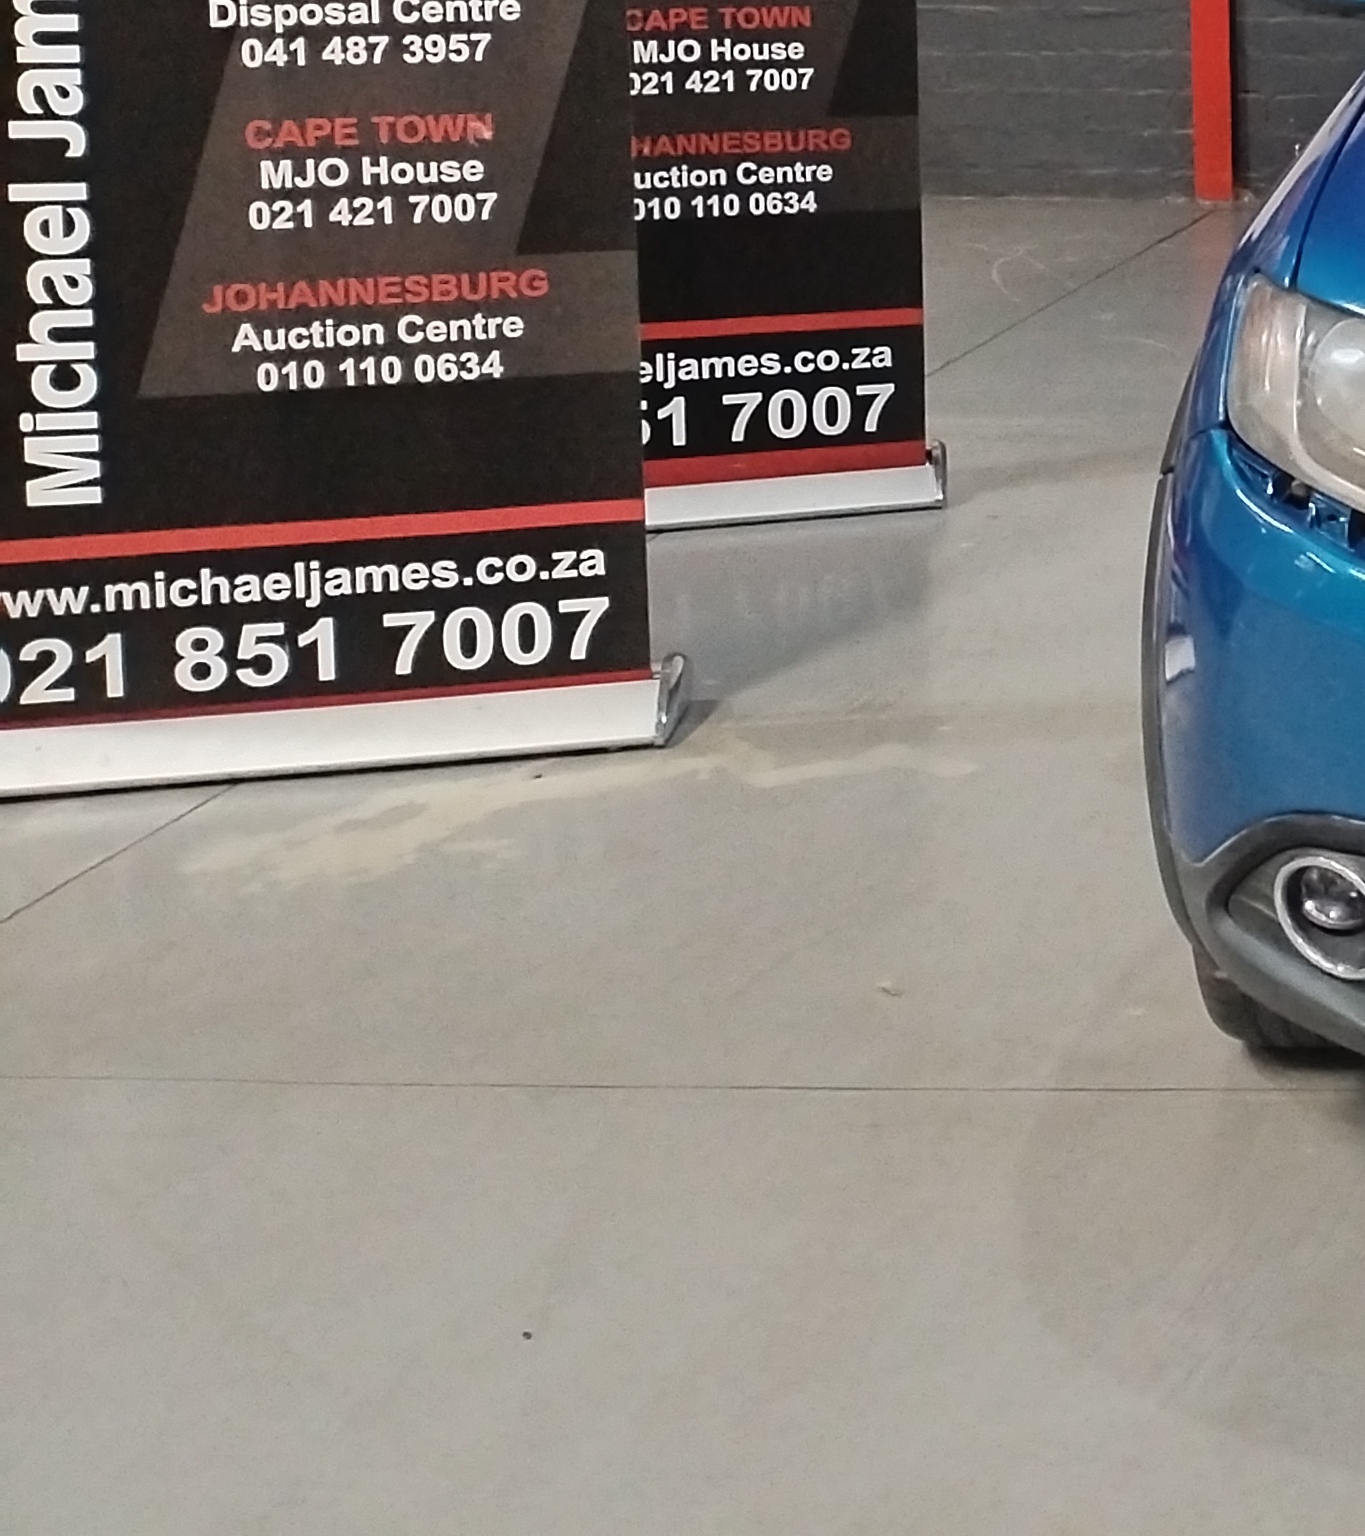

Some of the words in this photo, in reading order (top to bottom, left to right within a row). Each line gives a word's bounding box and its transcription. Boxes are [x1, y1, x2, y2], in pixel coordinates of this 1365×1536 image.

[721, 6, 811, 28] TOWN
[242, 37, 305, 67] 041
[322, 36, 389, 65] 487
[403, 33, 491, 63] 3957
[633, 39, 701, 63] MJO
[711, 39, 804, 61] House
[685, 70, 733, 92] 421
[746, 68, 814, 91] 7007
[245, 117, 357, 149] CAPE
[374, 114, 492, 143] TOWN
[632, 128, 851, 155] HANNESBURG
[260, 158, 349, 189] MJO
[362, 156, 484, 185] House
[634, 165, 726, 189] uction
[737, 162, 832, 184] Centre
[249, 199, 312, 230] 021
[329, 196, 392, 226] 421
[409, 192, 497, 223] 7007
[691, 194, 739, 217] 110
[750, 191, 817, 215] 0634
[204, 269, 548, 313] JOHANNESBURG
[8, 182, 102, 506] Michael
[232, 319, 384, 352] Auction
[398, 313, 524, 343] Centre
[257, 360, 325, 391] 010
[339, 356, 402, 386] 110
[415, 350, 504, 382] 0634
[640, 347, 894, 393] eljames.co.za
[722, 383, 894, 441] 7007
[0, 544, 609, 624] ww.michaeljames.co.za
[0, 633, 124, 704] 21
[174, 617, 335, 691] 851
[383, 597, 609, 675] 7007
